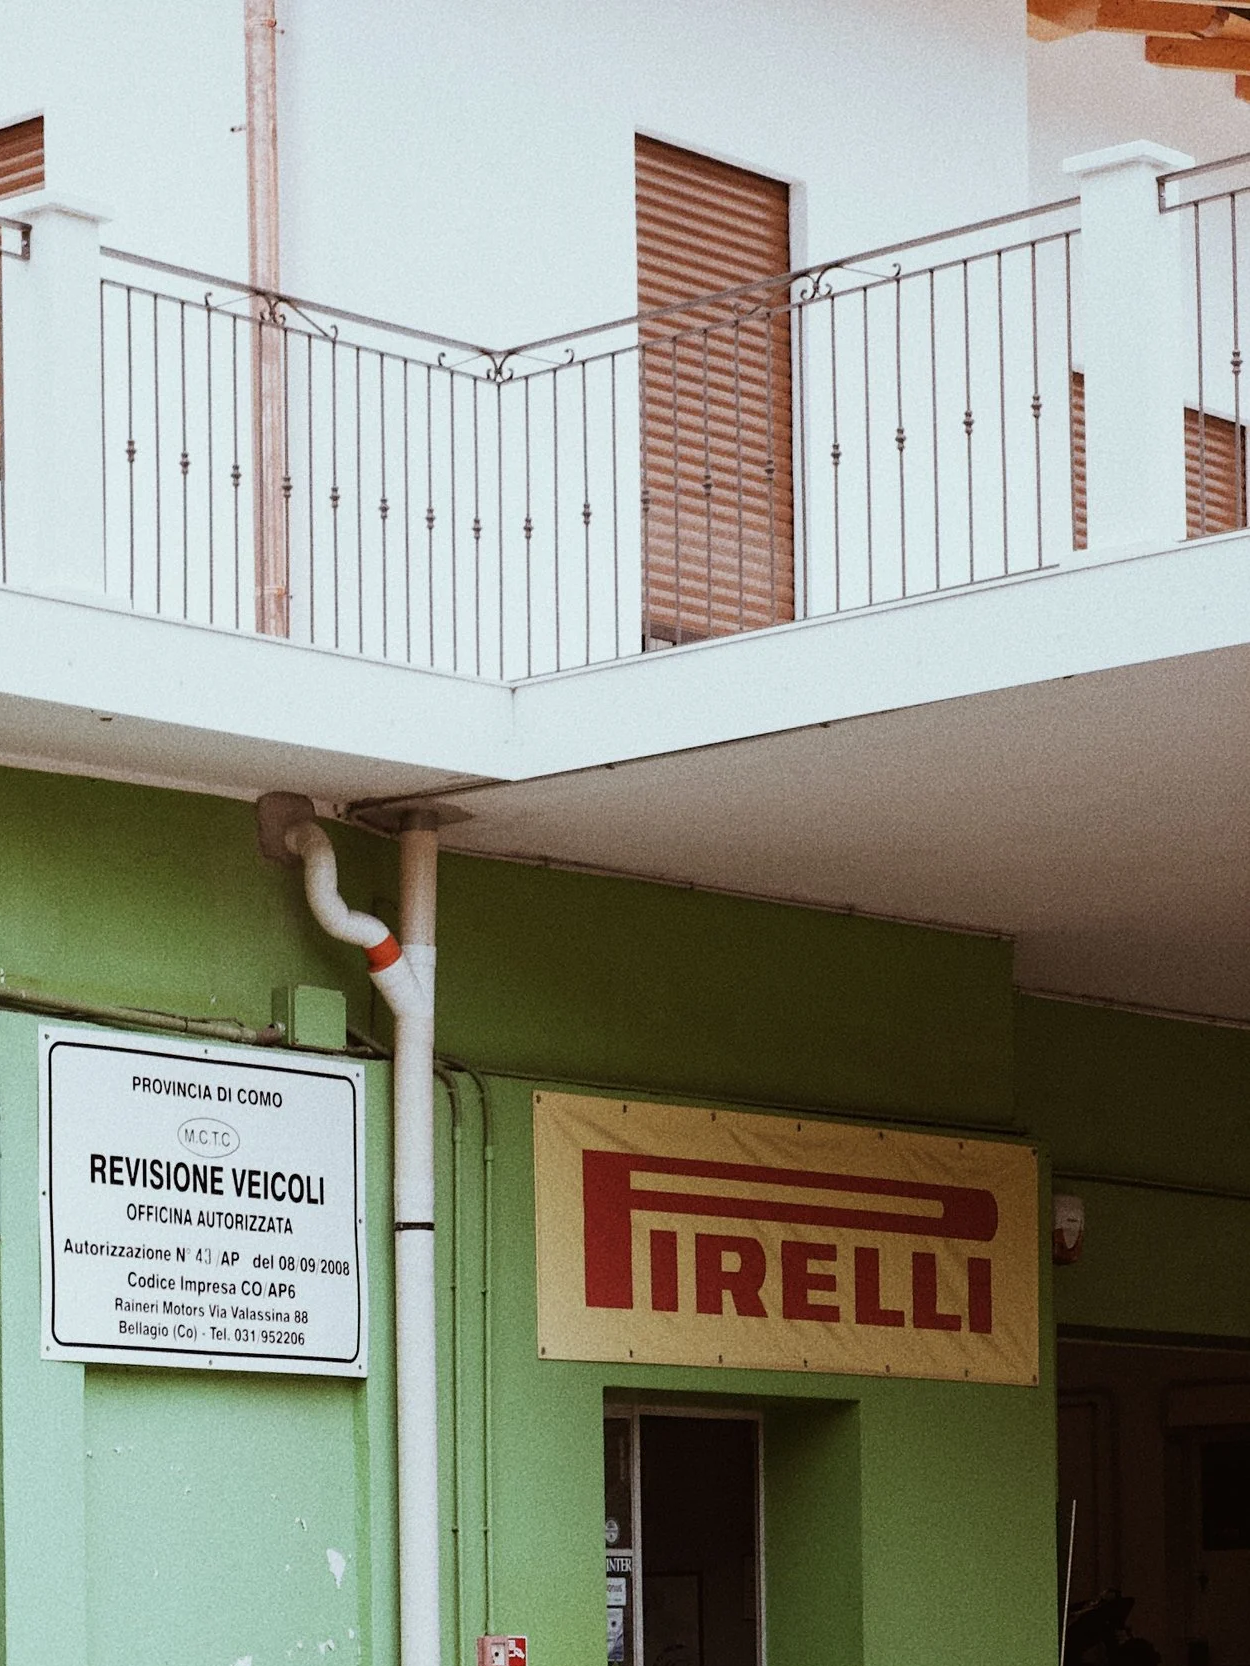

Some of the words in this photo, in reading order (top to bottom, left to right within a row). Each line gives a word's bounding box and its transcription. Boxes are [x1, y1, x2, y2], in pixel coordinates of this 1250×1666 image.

[132, 1075, 213, 1101] PROVINCIA
[216, 1086, 233, 1103] DI
[236, 1088, 283, 1109] COMO
[90, 1153, 225, 1197] REVISIONE
[231, 1167, 325, 1206] VEICOLI
[126, 1202, 193, 1227] OFFICINA
[196, 1209, 294, 1236] AUTORIZZATA
[63, 1237, 172, 1262] Autorizzazione
[252, 1253, 274, 1270] del
[278, 1255, 351, 1277] 08/09/2008
[582, 1148, 998, 1335] PIRELLI
[127, 1271, 176, 1291] Codice
[180, 1275, 237, 1297] Impresa
[240, 1280, 296, 1300] CO/AP6
[114, 1297, 159, 1314] Raineri
[162, 1300, 205, 1318] Motors
[208, 1303, 228, 1319] Via
[230, 1305, 291, 1323] Valassina
[294, 1310, 309, 1325] 88
[118, 1320, 169, 1340] Bellagio
[172, 1324, 198, 1341] (Co)
[210, 1326, 231, 1341] Tel.
[234, 1328, 306, 1346] 031/952206
